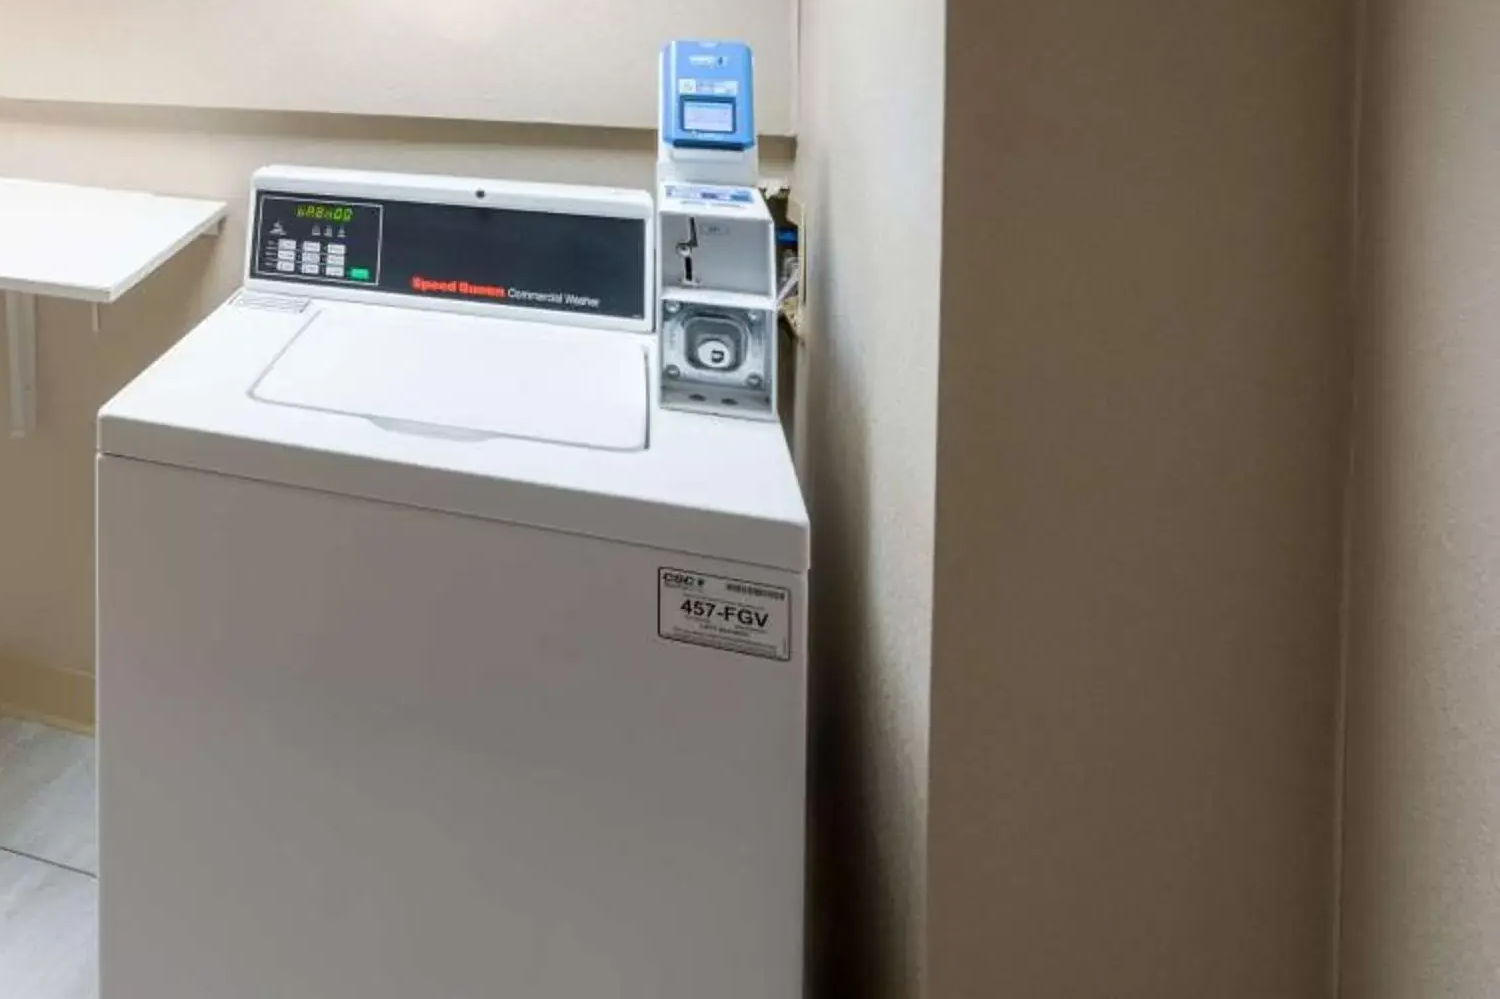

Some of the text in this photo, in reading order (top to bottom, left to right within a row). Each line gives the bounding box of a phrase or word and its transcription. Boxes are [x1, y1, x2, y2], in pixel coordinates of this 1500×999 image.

[411, 275, 600, 308] Speed Queen Commercial Washer
[680, 599, 769, 627] 457-FGV
